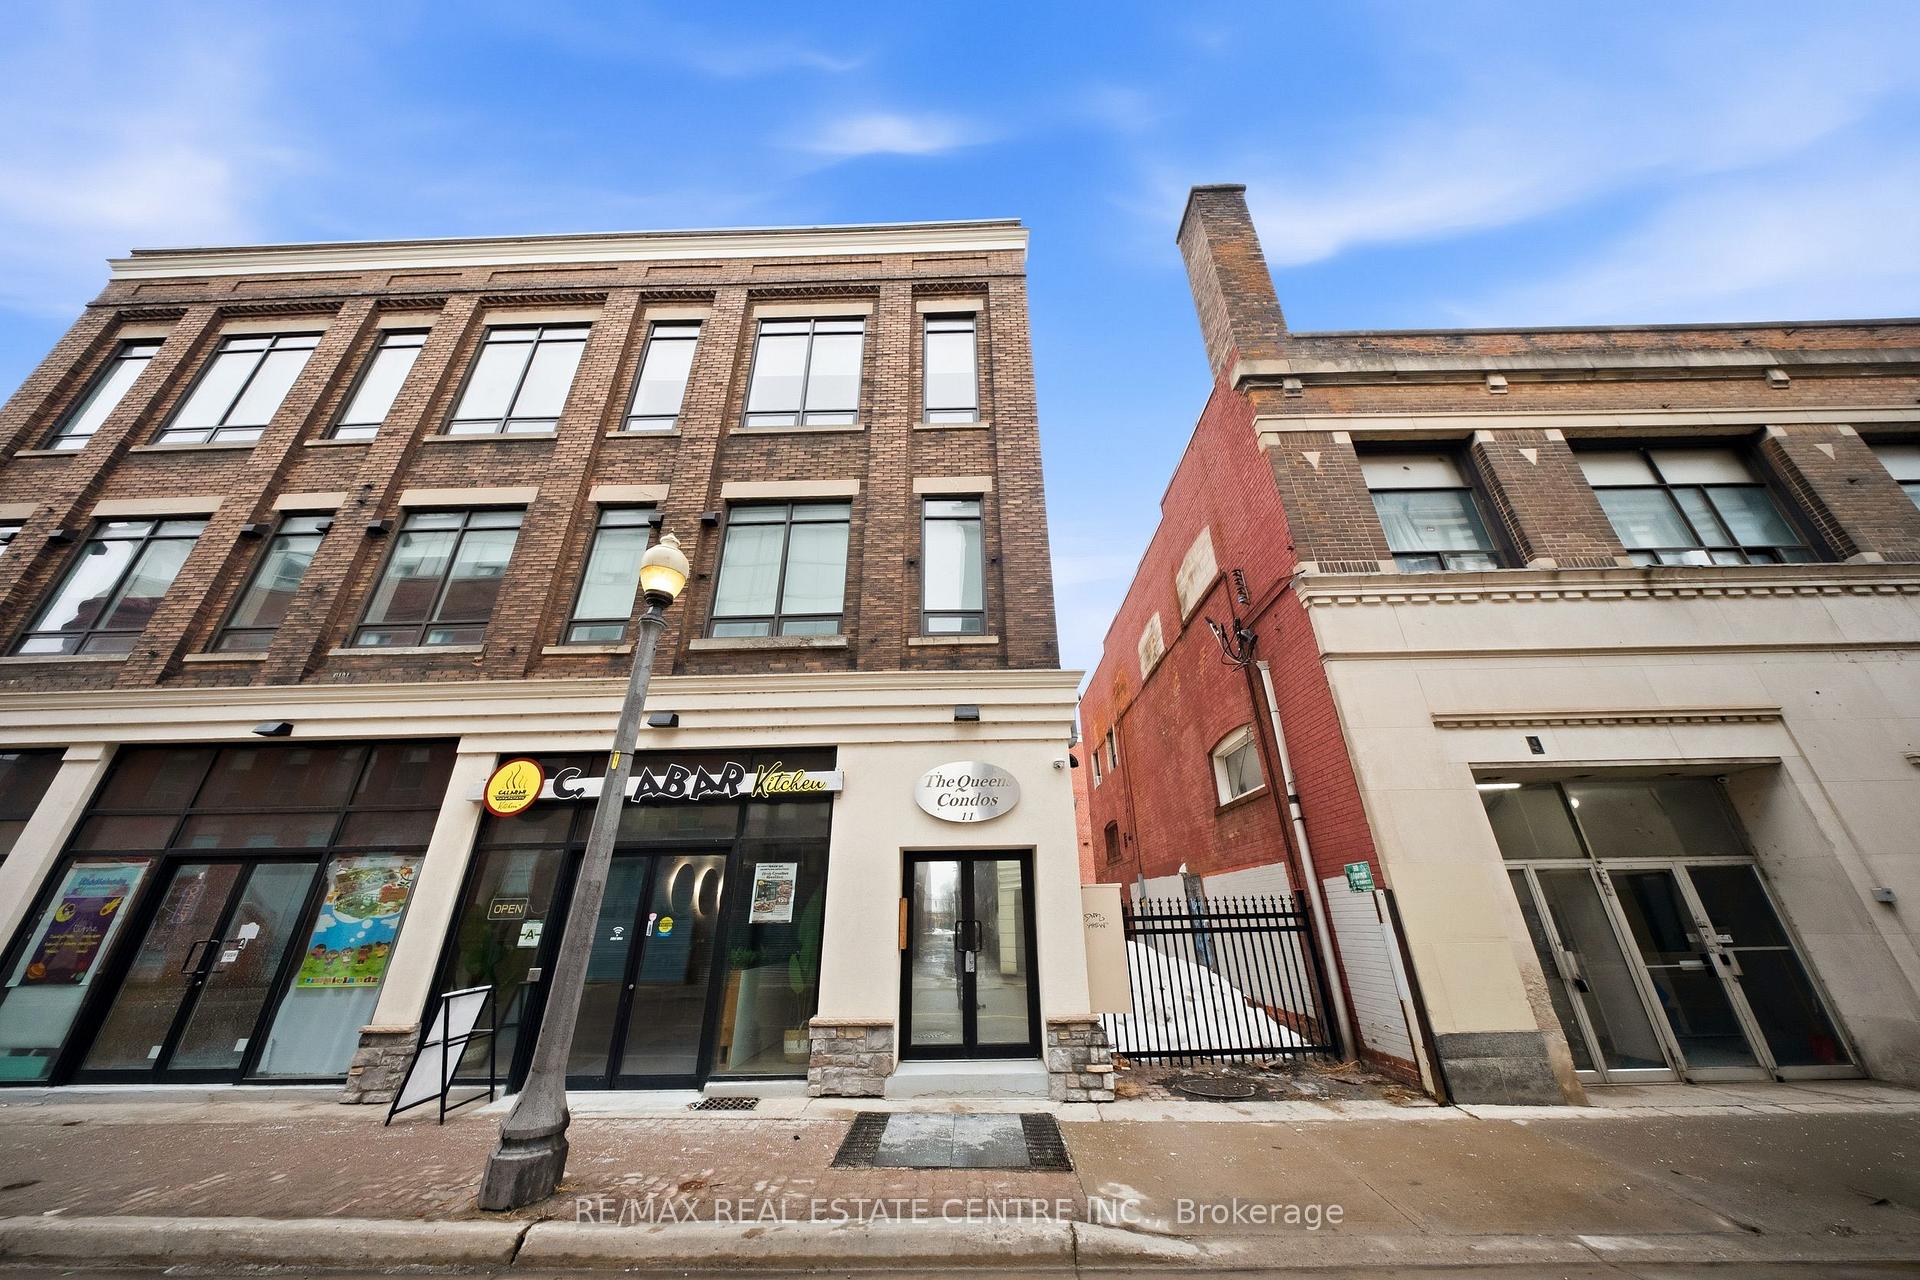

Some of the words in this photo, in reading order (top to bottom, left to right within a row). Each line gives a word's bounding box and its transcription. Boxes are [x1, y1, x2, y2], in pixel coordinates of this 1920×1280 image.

[552, 761, 746, 803] CABAR
[751, 761, 826, 798] Kitchen
[924, 774, 955, 788] The
[955, 774, 1010, 793] Queen
[937, 792, 999, 807] Condos
[961, 812, 974, 821] 11
[493, 904, 524, 914] OPEN
